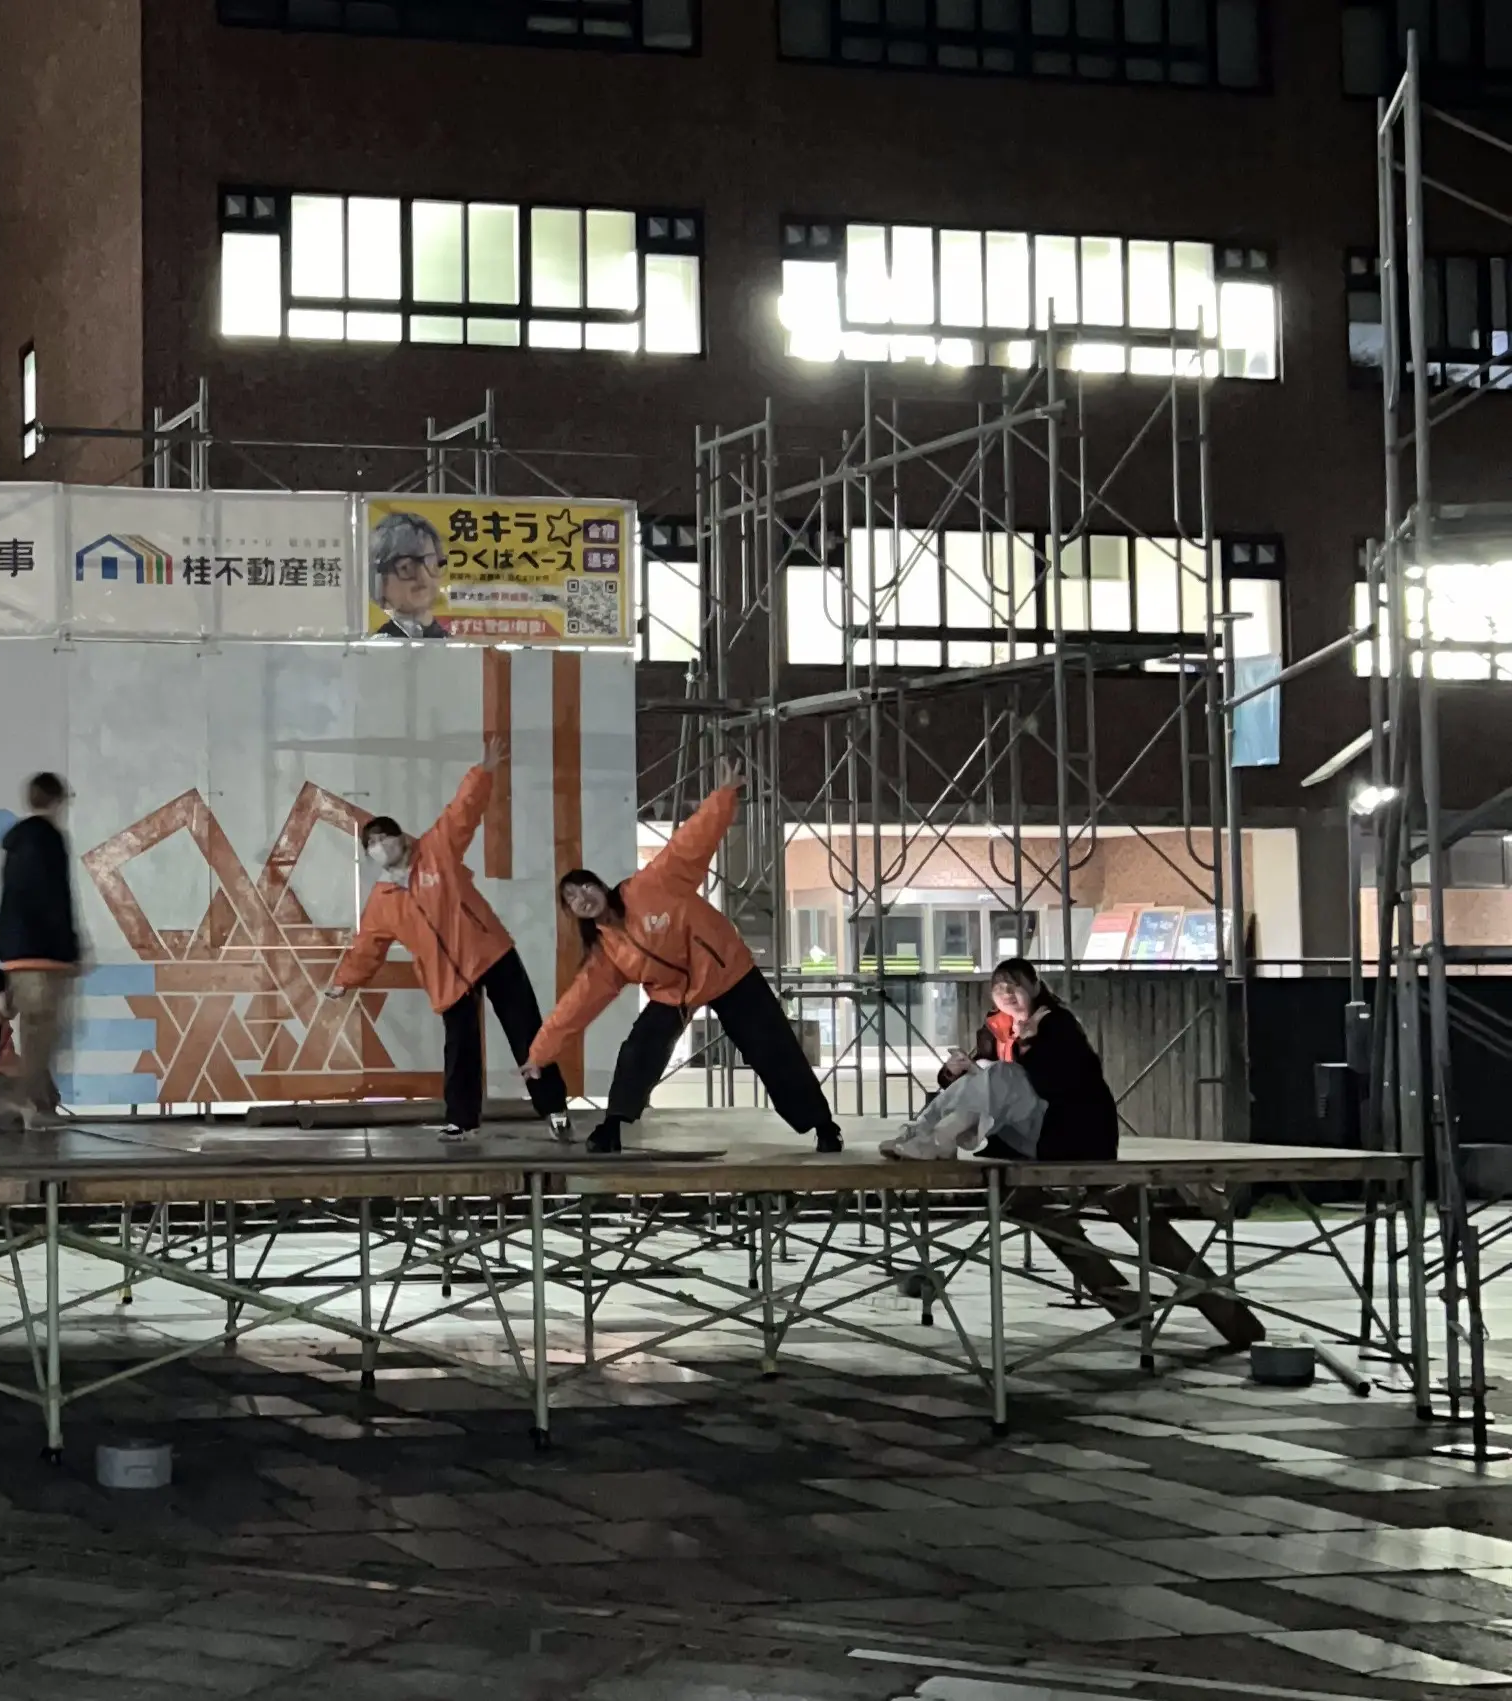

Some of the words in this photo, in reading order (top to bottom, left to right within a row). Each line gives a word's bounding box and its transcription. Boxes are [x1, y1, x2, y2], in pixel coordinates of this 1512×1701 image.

[448, 549, 576, 572] つくばベース
